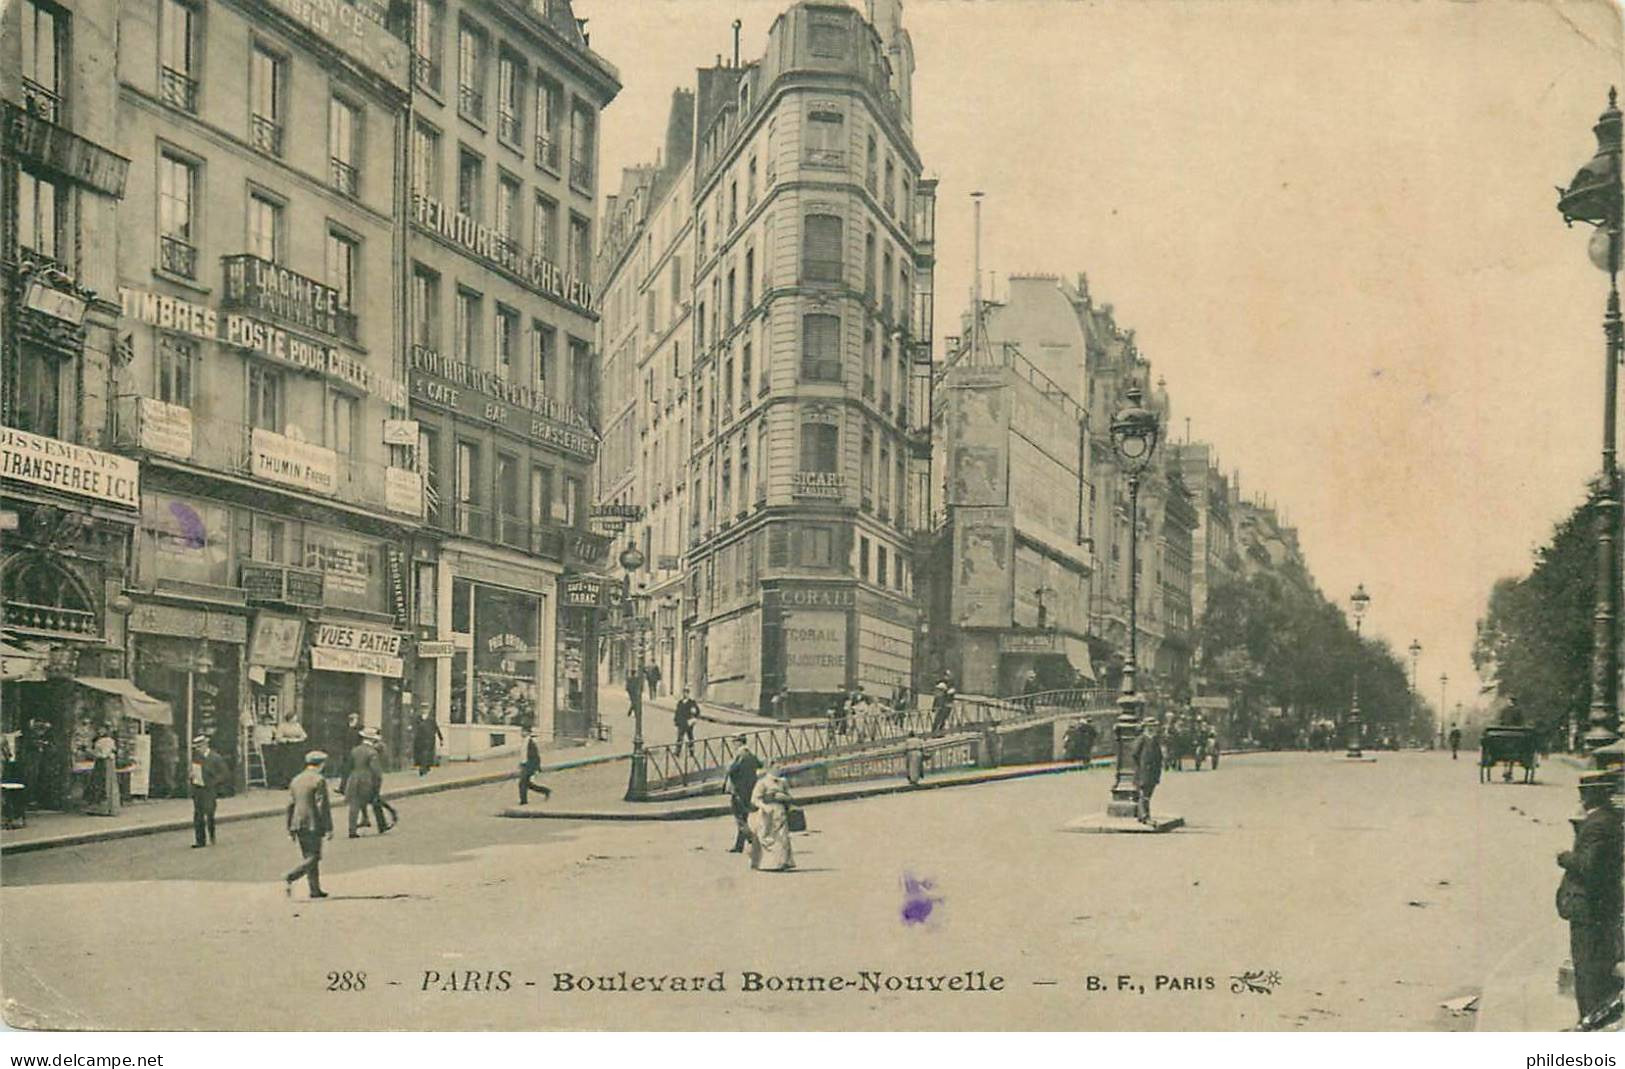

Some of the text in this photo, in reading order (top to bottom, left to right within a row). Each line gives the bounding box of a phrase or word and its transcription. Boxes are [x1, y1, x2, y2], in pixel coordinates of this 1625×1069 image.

[417, 195, 502, 263] TEINTURE
[531, 255, 597, 314] CHEVEUX
[119, 286, 218, 337] TIMBRES
[228, 314, 287, 358] POSTE
[290, 339, 325, 372] POUR
[485, 403, 508, 424] BAR
[259, 453, 301, 479] THUMIN
[106, 479, 136, 501] ICI
[570, 593, 597, 604] TABAC
[781, 589, 854, 606] CORAIL
[320, 626, 354, 647] VUES
[790, 628, 838, 641] CORAIL
